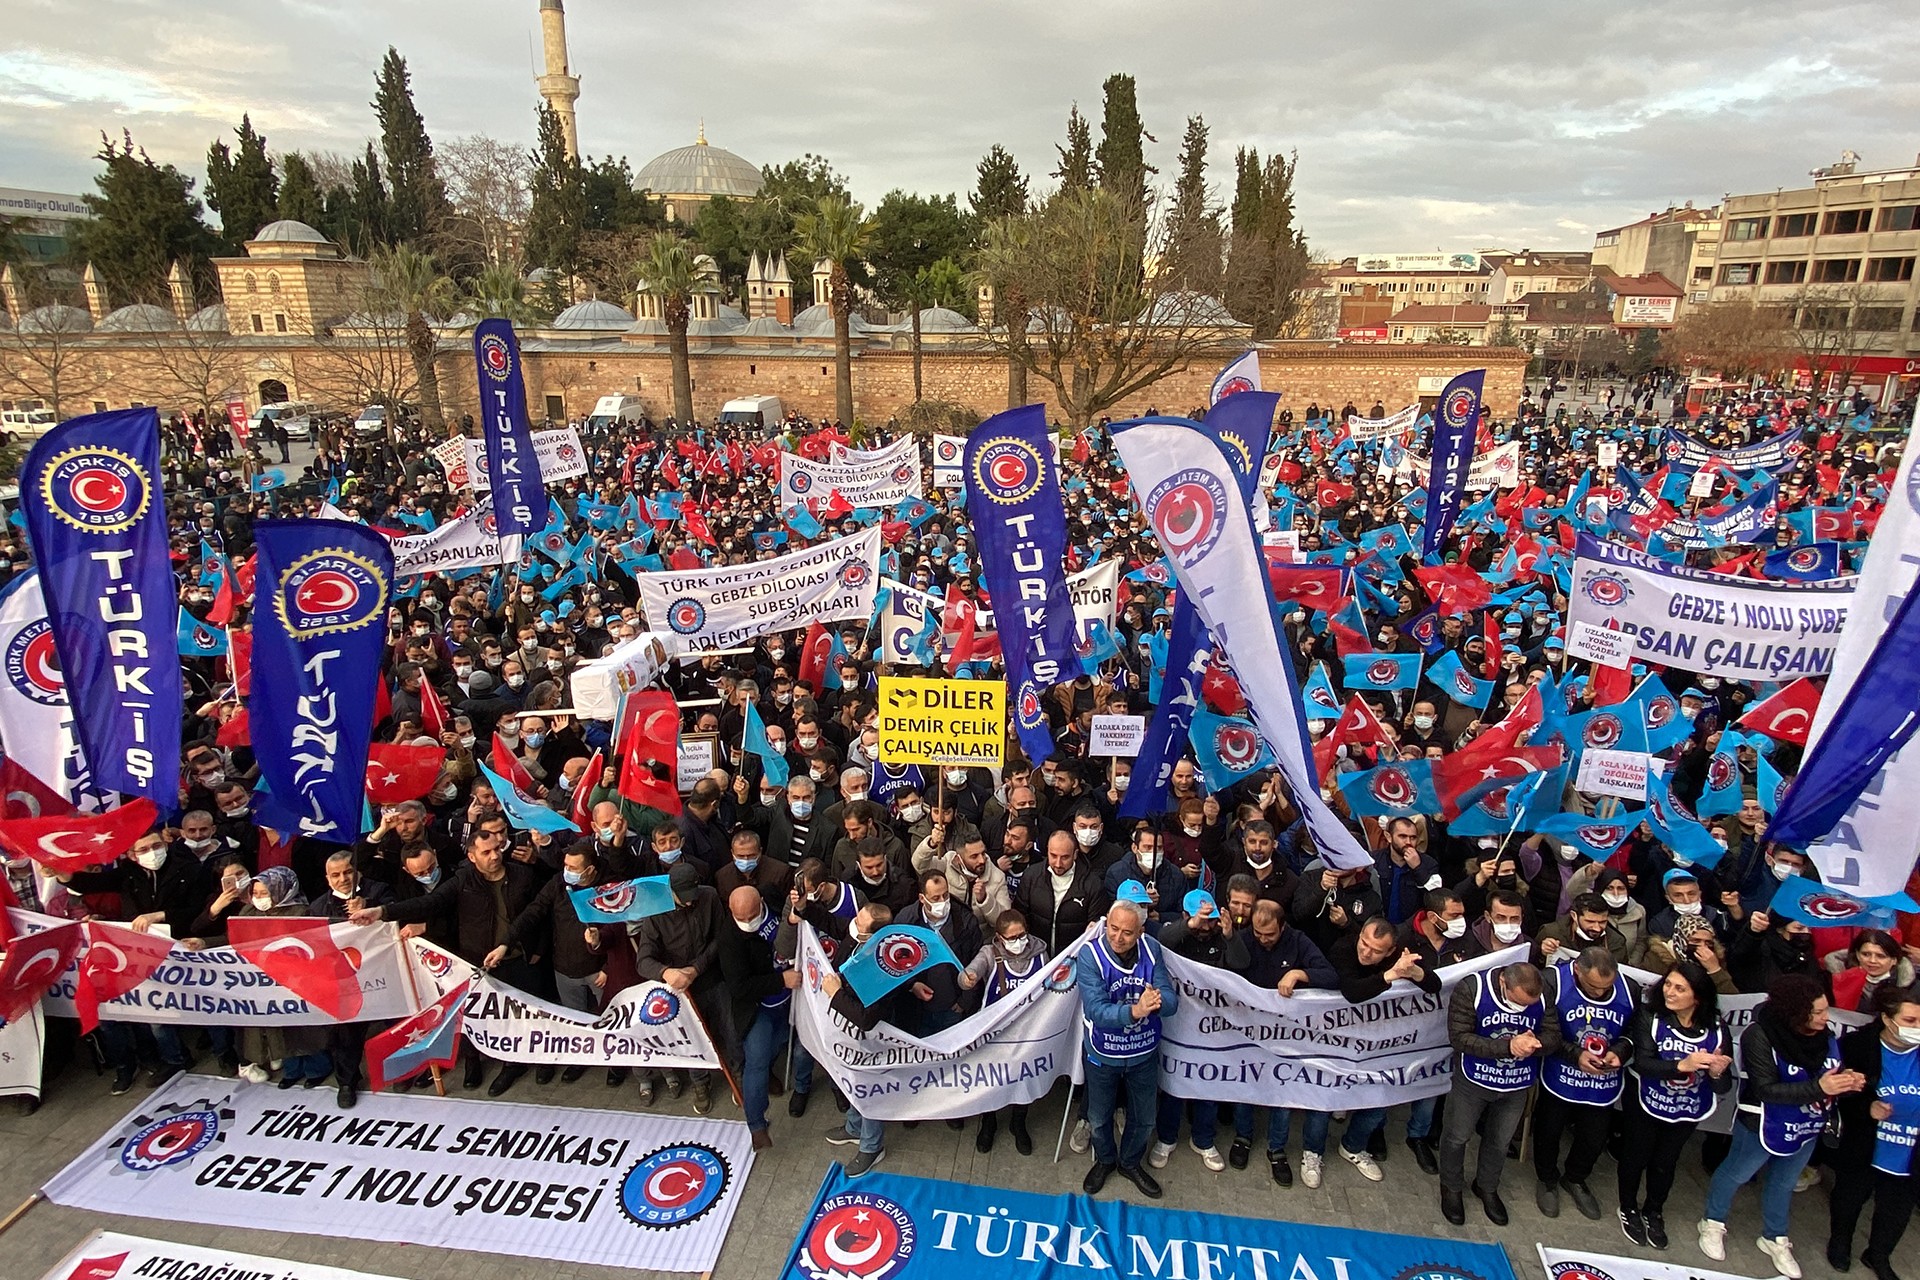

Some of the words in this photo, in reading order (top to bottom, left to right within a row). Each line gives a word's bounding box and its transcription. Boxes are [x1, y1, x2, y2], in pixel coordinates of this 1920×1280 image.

[494, 390, 533, 528] TÜRK-İŞ
[984, 444, 1029, 465] TÜRK-İŞ
[58, 455, 130, 480] TÜRK-İŞ
[996, 483, 1029, 498] 1952
[1434, 435, 1463, 547] TÜRK-İŞ
[78, 508, 128, 526] 1952
[659, 576, 710, 596] TÜRK
[715, 568, 774, 585] METAL
[711, 586, 759, 606] GEBZE
[761, 571, 830, 596] DİLOVASI
[749, 594, 801, 620] ŞUBESİ
[1005, 513, 1060, 686] TÜRK-İŞ
[1668, 592, 1725, 624] GEBZE
[1730, 603, 1738, 628] 1
[1744, 603, 1794, 632] NOLU
[1800, 607, 1850, 640] ŞUBE
[687, 626, 750, 653] ADİENT
[1585, 627, 1622, 643] UZLAŞMA
[1588, 636, 1614, 648] YOKSA
[8, 648, 23, 683] TÜRK
[17, 620, 52, 646] META
[1577, 641, 1621, 657] MÜCADELE
[1589, 651, 1605, 661] VAR
[1704, 638, 1837, 678] ÇALIŞAN
[90, 548, 155, 788] TÜRK-İŞ
[924, 685, 994, 710] DİLER
[884, 715, 944, 734] DEMİR
[949, 717, 999, 738] ÇELİK
[1121, 723, 1141, 731] DEĞİL
[883, 738, 1000, 758] ÇALIŞANLARI
[1598, 760, 1620, 769] ASLA
[1622, 762, 1647, 773] YALN
[1604, 767, 1645, 782] DEĞİLSİN
[1598, 777, 1646, 791] BAŞKANIM
[147, 989, 311, 1017] ÇALIŞANLARI
[1171, 977, 1230, 1008] TÜRK
[1481, 1011, 1537, 1030] GÖREVLİ
[1565, 1004, 1624, 1027] GÖREVLİ
[465, 1023, 522, 1053] Pelzer
[529, 1030, 595, 1055] Pimsa
[1102, 1031, 1129, 1043] TÜRK
[1129, 1028, 1157, 1041] METAL
[1103, 1036, 1155, 1051] SENDİKASI
[1259, 1023, 1353, 1048] DİLOVASI
[1354, 1029, 1418, 1054] ŞUBESİ
[1657, 1039, 1706, 1054] GÖREV
[833, 1042, 885, 1066] GEBZE
[908, 1052, 1055, 1094] ÇALIŞANLARI
[1162, 1055, 1266, 1083] UTOLİV
[1473, 1072, 1531, 1084] SENDİKASI
[1474, 1062, 1504, 1075] TÜRK
[1560, 1064, 1597, 1078] TÜRK
[1559, 1074, 1618, 1090] SENDİKASI
[1647, 1086, 1675, 1105] TÜRK
[132, 1121, 164, 1144] TÜRK
[165, 1111, 204, 1125] METAL
[247, 1104, 344, 1144] TÜRK
[332, 1114, 447, 1153] METAL
[446, 1125, 630, 1169] SENDİKASI
[643, 1151, 720, 1178] TÜRK-İŞ
[195, 1154, 326, 1196] GEBZE
[321, 1165, 347, 1199] 1
[352, 1167, 462, 1209] NOLU
[453, 1178, 608, 1224] ŞUBESİ
[637, 1205, 688, 1222] 1952
[823, 1195, 871, 1213] METAL
[874, 1198, 914, 1259] SENDİKASI
[931, 1205, 1113, 1270] TÜRK
[1552, 1263, 1582, 1274] METAL
